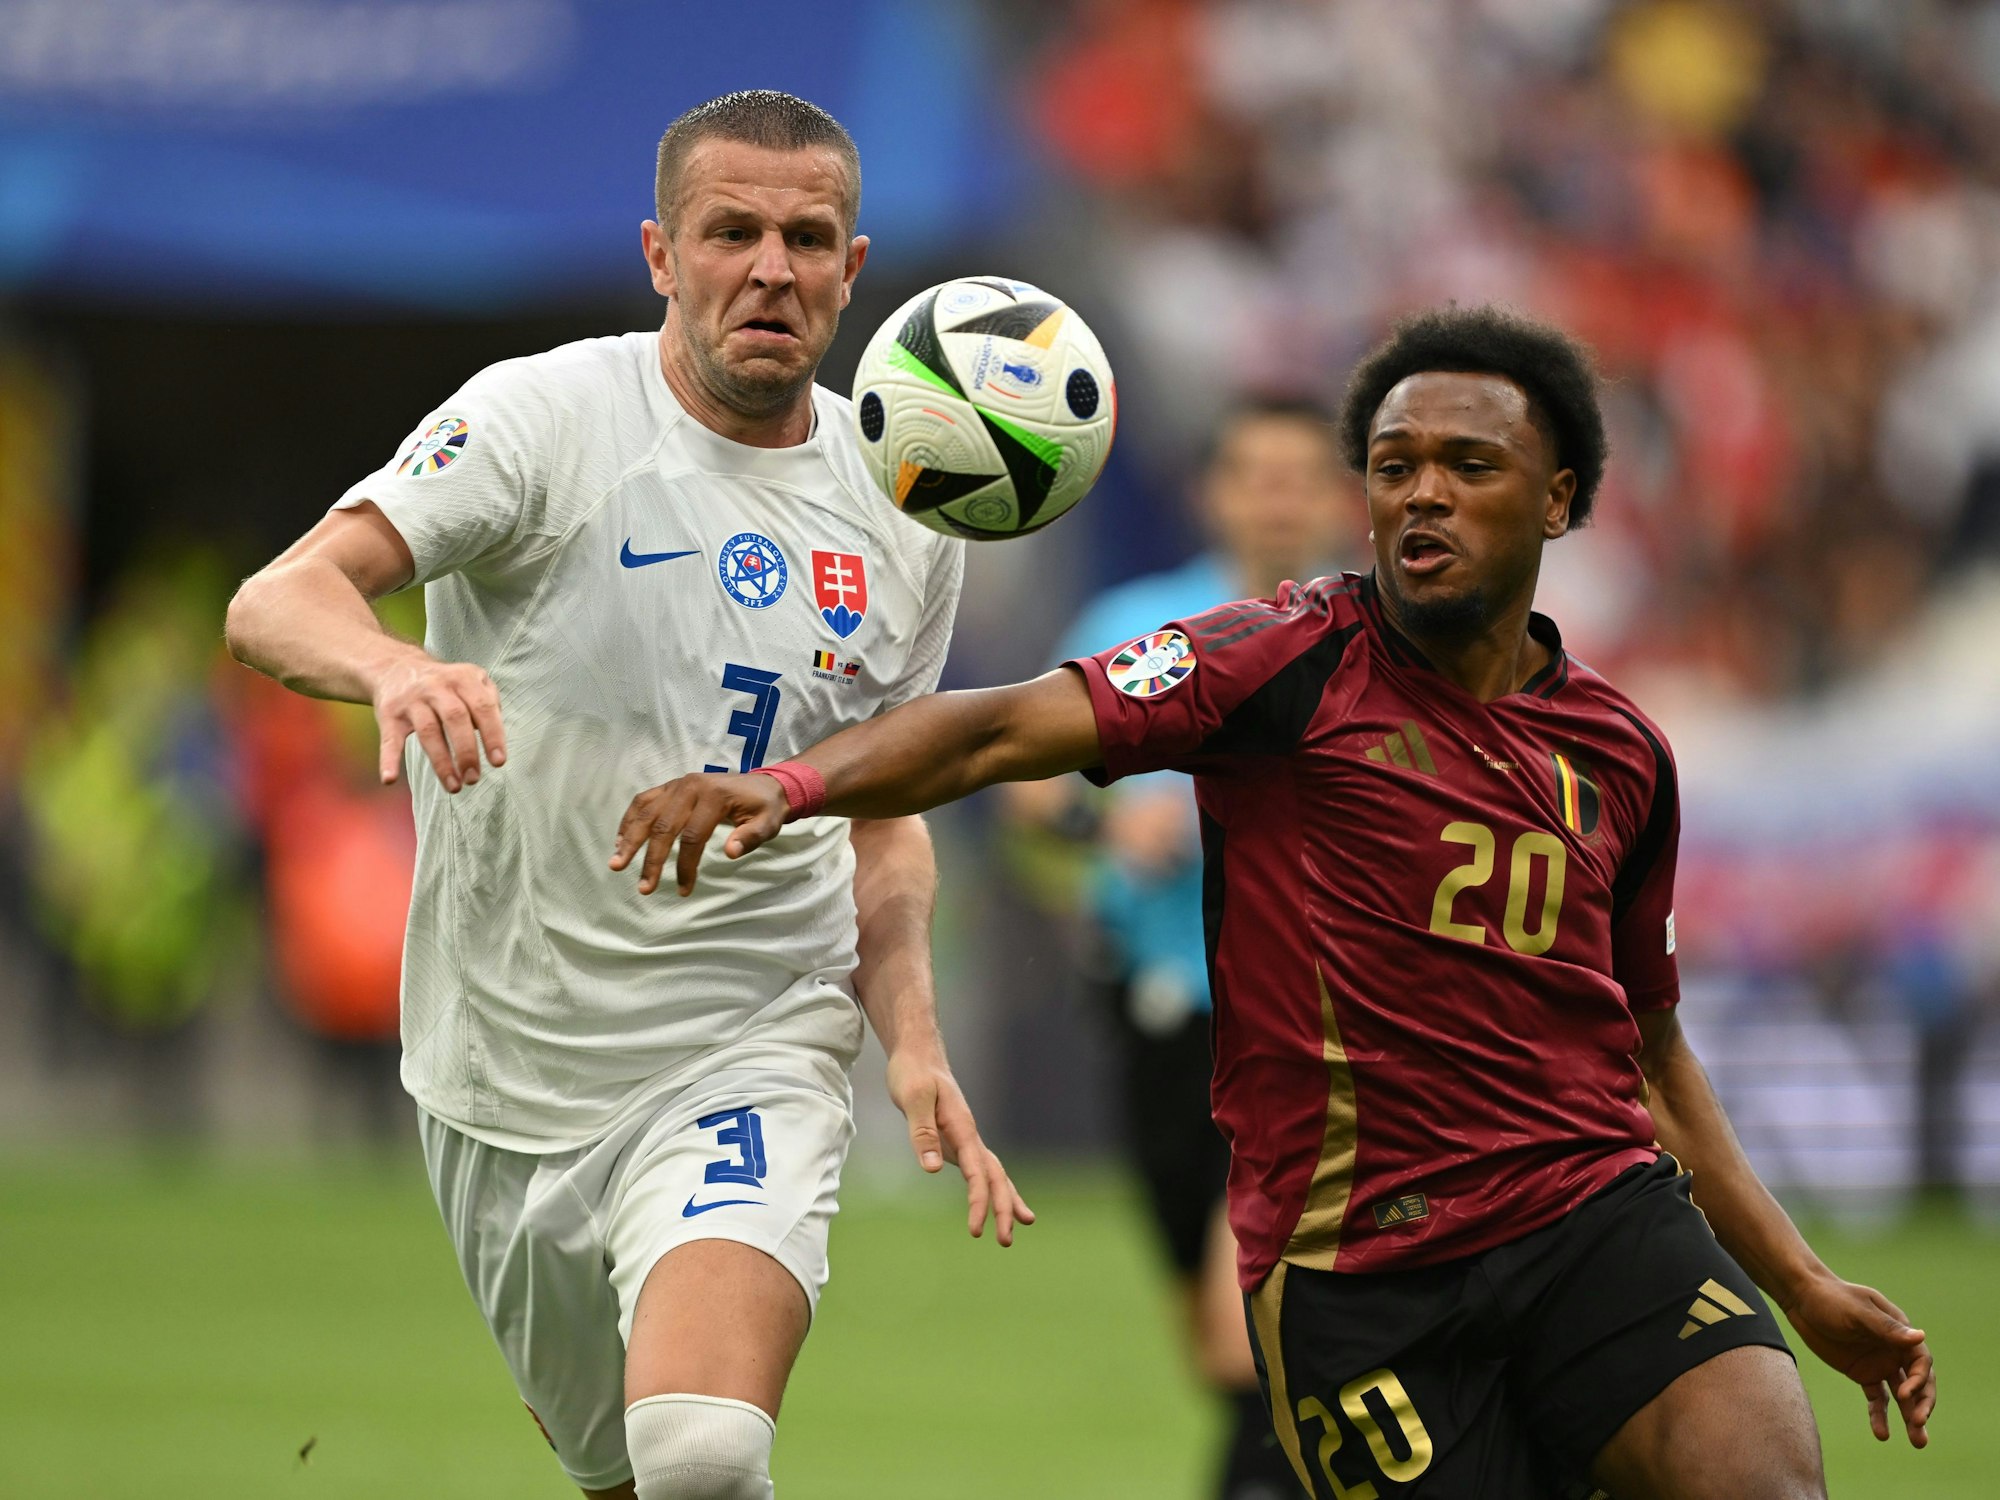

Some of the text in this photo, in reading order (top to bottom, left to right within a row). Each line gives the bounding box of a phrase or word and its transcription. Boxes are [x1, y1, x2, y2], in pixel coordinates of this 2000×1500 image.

[743, 598, 764, 607] SFZ
[704, 663, 783, 774] 3
[812, 670, 837, 681] FRANKFURT
[1429, 821, 1567, 956] 20
[697, 1105, 767, 1190] 3
[1297, 1367, 1433, 1500] 20
